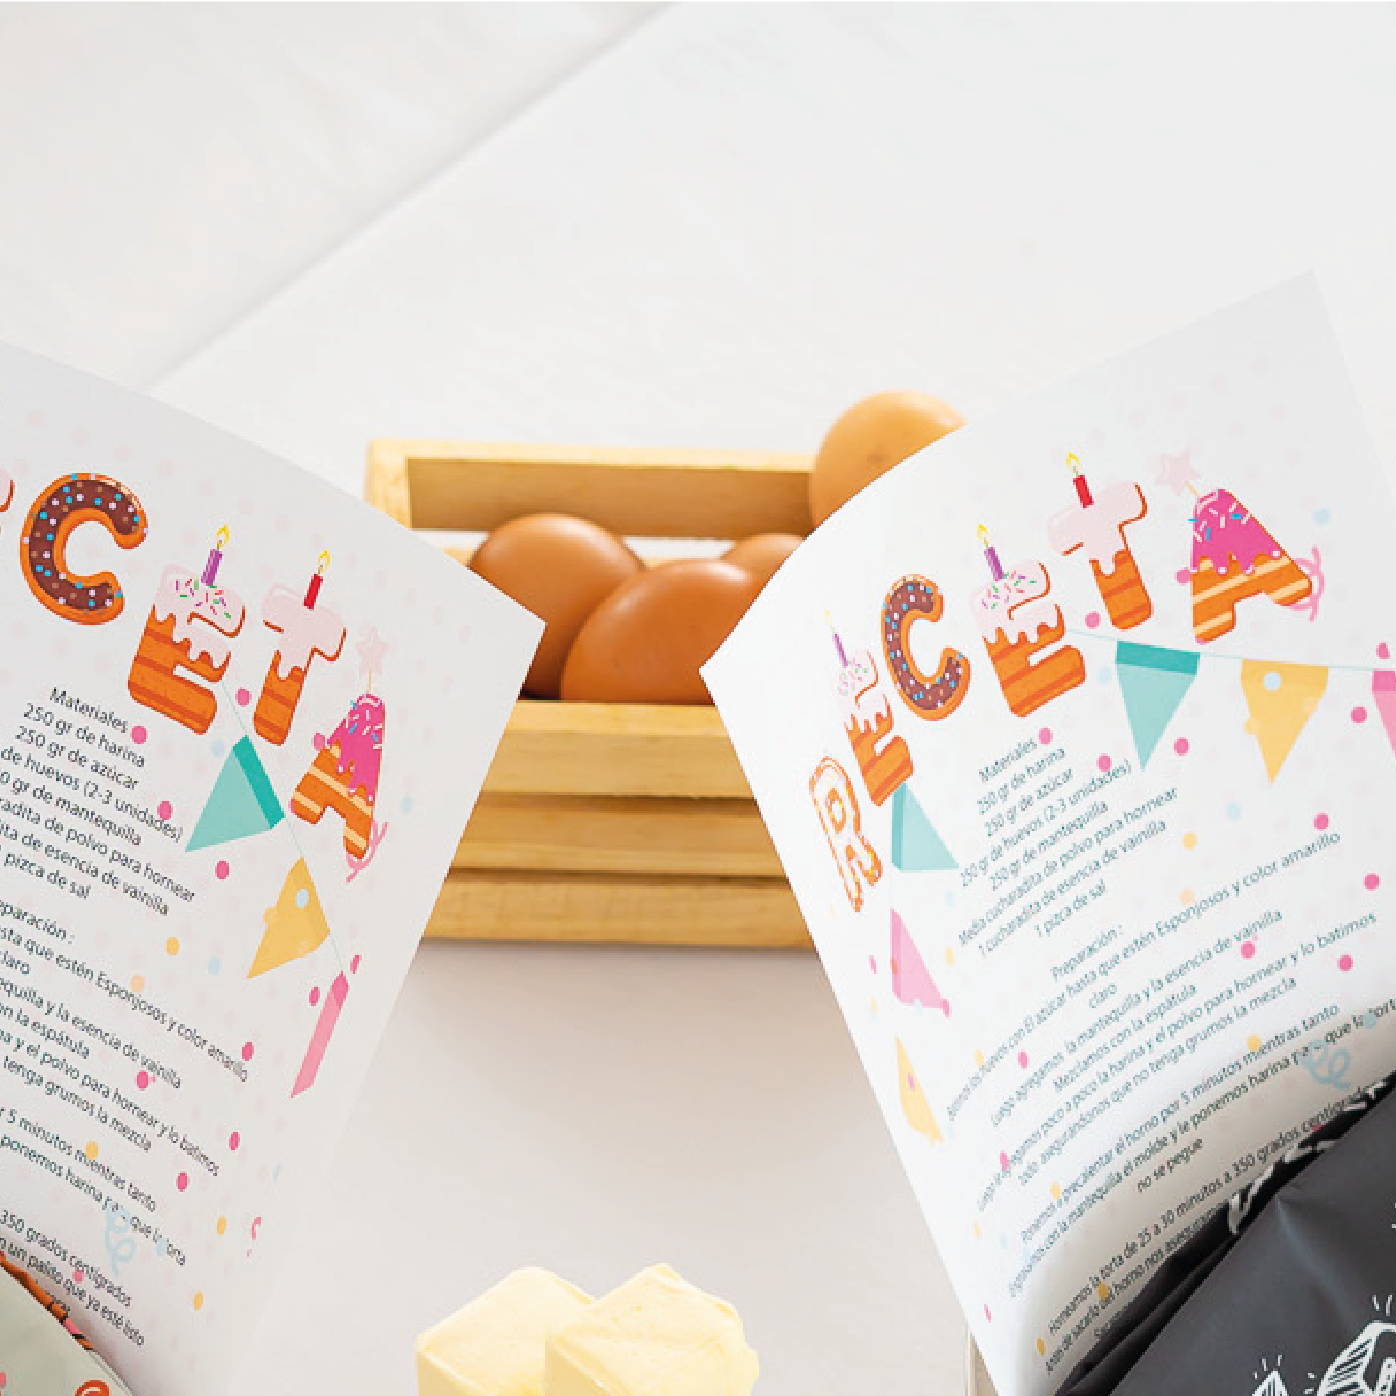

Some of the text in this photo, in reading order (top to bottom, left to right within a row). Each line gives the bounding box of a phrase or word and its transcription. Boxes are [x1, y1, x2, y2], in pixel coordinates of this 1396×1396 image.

[0, 472, 388, 860] CETA
[808, 478, 1314, 914] RECETA
[15, 725, 45, 748] 250
[47, 742, 66, 759] gr
[68, 749, 87, 767] de
[23, 703, 144, 768] 250 gr de harina
[50, 687, 128, 734] Materiales
[24, 753, 79, 790] huevos
[978, 790, 997, 815] 250
[1011, 773, 1026, 790] de
[1026, 748, 1065, 779] harina
[979, 738, 1037, 781] Materiales
[32, 785, 53, 804] de
[55, 796, 141, 846] mantequilla
[960, 862, 979, 887] 250
[990, 845, 1003, 862] de
[1002, 818, 1043, 850] huevos
[985, 813, 1004, 838] 250
[1019, 794, 1034, 811] de
[989, 866, 1009, 892] 250
[1022, 849, 1037, 865] de
[1038, 800, 1109, 852] mantequilla
[1043, 860, 1059, 878] de
[1059, 837, 1094, 868] polvo
[1094, 819, 1125, 845] para
[1123, 787, 1179, 824] hornear
[3, 853, 91, 900] pizca de sal
[21, 833, 169, 916] de esencia de vainilla
[44, 816, 195, 902] de polvo para hornear
[1041, 890, 1056, 907] de
[1057, 859, 1101, 895] esencia
[1102, 847, 1119, 865] de
[1119, 819, 1167, 853] vainilla
[1043, 905, 1072, 938] pizca
[1072, 893, 1088, 911] de
[1065, 969, 1097, 999] hasta
[1099, 954, 1121, 976] que
[1155, 887, 1230, 937] Esponjosos
[1242, 860, 1279, 888] color
[1281, 832, 1341, 869] amarillo
[16, 1007, 30, 1027] la
[24, 938, 54, 961] que
[95, 970, 167, 1025] Esponjosos
[177, 1023, 208, 1050] color
[207, 1044, 248, 1083] amarillo
[1078, 909, 1284, 1044] mantequilla la esencia de vainilla
[1089, 983, 1118, 1009] claro
[58, 1002, 181, 1089] la esencia de vainilla
[1040, 1106, 1065, 1138] poco
[1072, 1078, 1098, 1110] poco
[1108, 1045, 1146, 1078] harina
[1155, 1024, 1168, 1043] el
[1167, 1006, 1203, 1039] polvo
[1203, 987, 1234, 1016] para
[1234, 956, 1288, 995] hornear
[1300, 941, 1315, 957] lo
[1316, 912, 1376, 949] batimos
[1110, 1027, 1132, 1050] con
[1110, 977, 1297, 1102] que no tenga grumos la mezcla
[4, 1054, 152, 1153] tenga grumos la mezcla
[40, 1051, 220, 1177] polvo para hornear batimos
[1125, 1114, 1159, 1146] horno
[1160, 1099, 1181, 1123] por
[1191, 1059, 1242, 1099] minutos
[1302, 1004, 1339, 1033] tanto
[1134, 1135, 1169, 1167] molde
[1190, 1083, 1249, 1129] ponemos
[1248, 1056, 1291, 1088] harina
[1324, 1022, 1352, 1047] que
[19, 1117, 73, 1157] minutos
[127, 1182, 157, 1213] tanto
[65, 1165, 103, 1204] harina
[129, 1215, 153, 1239] que
[1100, 1252, 1125, 1281] torta
[1123, 1241, 1139, 1259] de
[1176, 1177, 1223, 1216] minutos
[1232, 1153, 1256, 1177] 350
[1257, 1125, 1301, 1165] grados
[1137, 1138, 1203, 1194] no se pegue
[26, 1227, 67, 1262] grados
[26, 1255, 63, 1285] palito
[63, 1278, 86, 1300] que
[85, 1293, 101, 1311] ya
